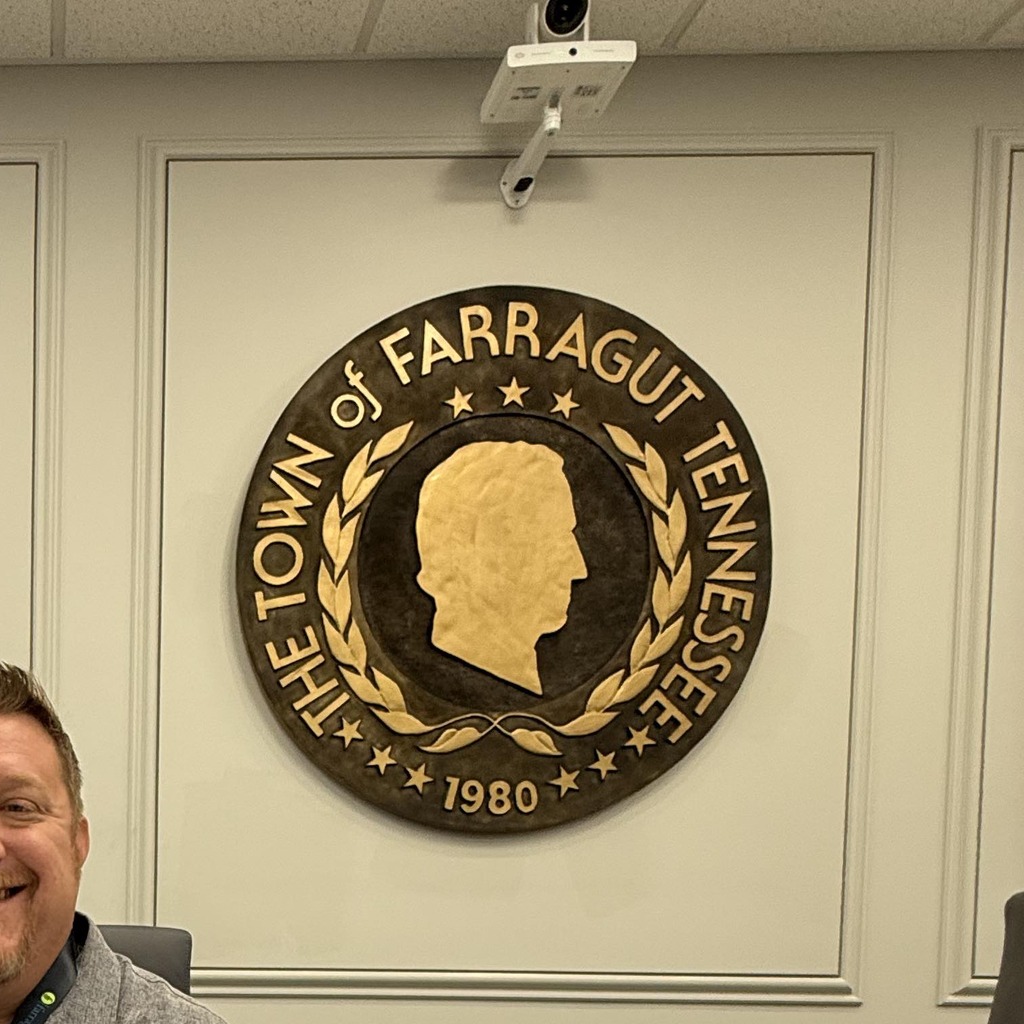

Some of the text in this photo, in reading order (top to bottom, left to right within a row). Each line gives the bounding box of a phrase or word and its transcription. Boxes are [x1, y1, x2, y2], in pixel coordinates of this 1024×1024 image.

[253, 301, 758, 744] THE TOWN of FARRAGUT TENNESSEE
[443, 776, 538, 815] 1980
